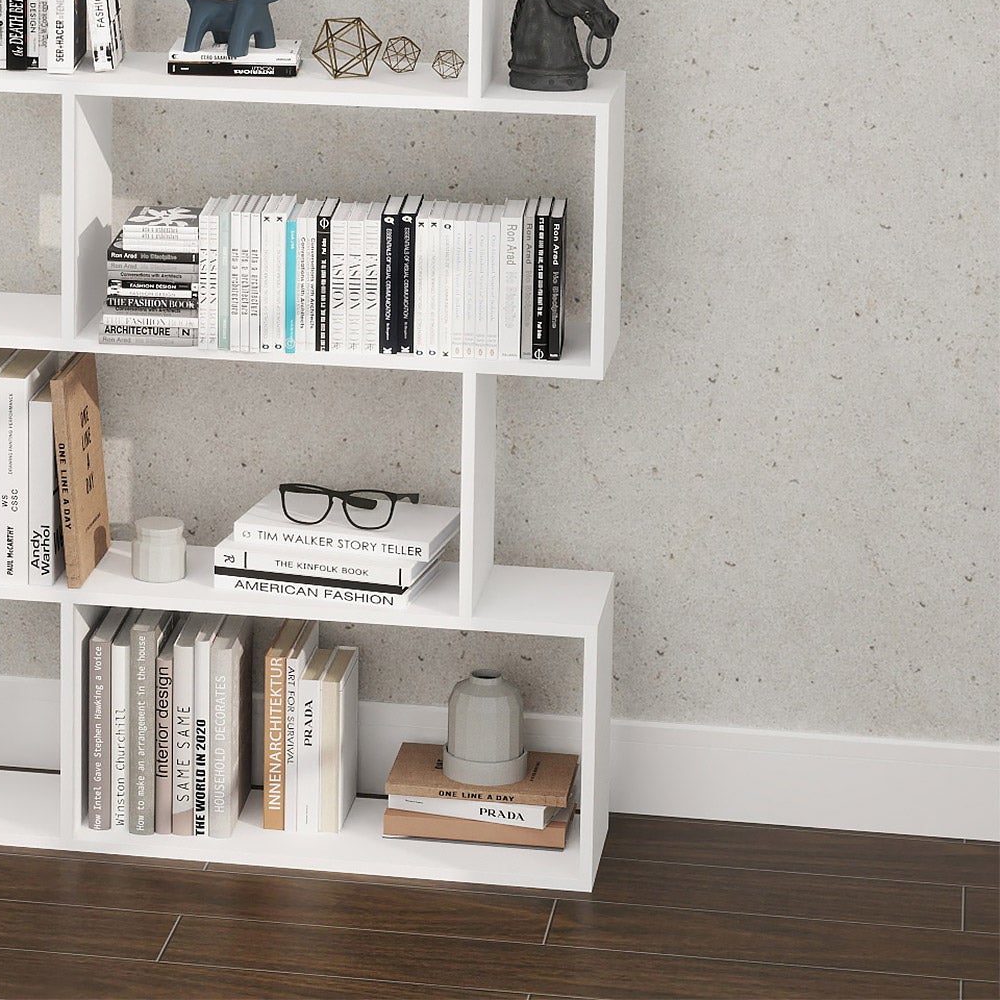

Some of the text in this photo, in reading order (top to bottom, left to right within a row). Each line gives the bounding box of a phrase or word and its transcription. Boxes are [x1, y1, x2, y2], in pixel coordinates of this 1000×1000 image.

[508, 224, 518, 242] Ron
[506, 244, 517, 266] Arad
[108, 298, 128, 306] THE
[128, 298, 168, 308] FASHION
[104, 326, 170, 336] ARCHITECTURE
[58, 443, 66, 464] ONE
[61, 469, 70, 494] LINE
[2, 494, 8, 508] WS
[64, 508, 72, 530] DAY
[30, 530, 42, 568] Andy
[41, 524, 50, 576] Warhol
[258, 530, 422, 557] TIM WALKER STORY TELLER
[274, 559, 369, 576] THE KINFOLK BOOK
[234, 579, 394, 606] AMERICAN FASHION
[137, 636, 146, 660] house
[137, 666, 146, 680] the
[94, 684, 104, 720] Hawking
[137, 686, 146, 696] in
[156, 666, 172, 778] Interior design
[286, 666, 296, 764] ART FOR SURVIVAL
[304, 700, 314, 747] PRADA
[94, 724, 103, 758] Stephen
[215, 675, 226, 813] HOUSEHOLD DECORATES
[268, 656, 283, 810] INNENARCHITEKTUR
[139, 760, 145, 770] an
[176, 706, 190, 802] SAME SAME
[94, 762, 102, 782] Gave
[115, 708, 126, 826] Winston Churchill
[195, 719, 206, 836] THE WORLD IN 2020
[136, 776, 145, 796] make
[438, 790, 457, 798] ONE
[462, 792, 484, 800] LINE
[137, 801, 145, 810] to
[480, 807, 524, 822] PRADA
[136, 816, 144, 831] How
